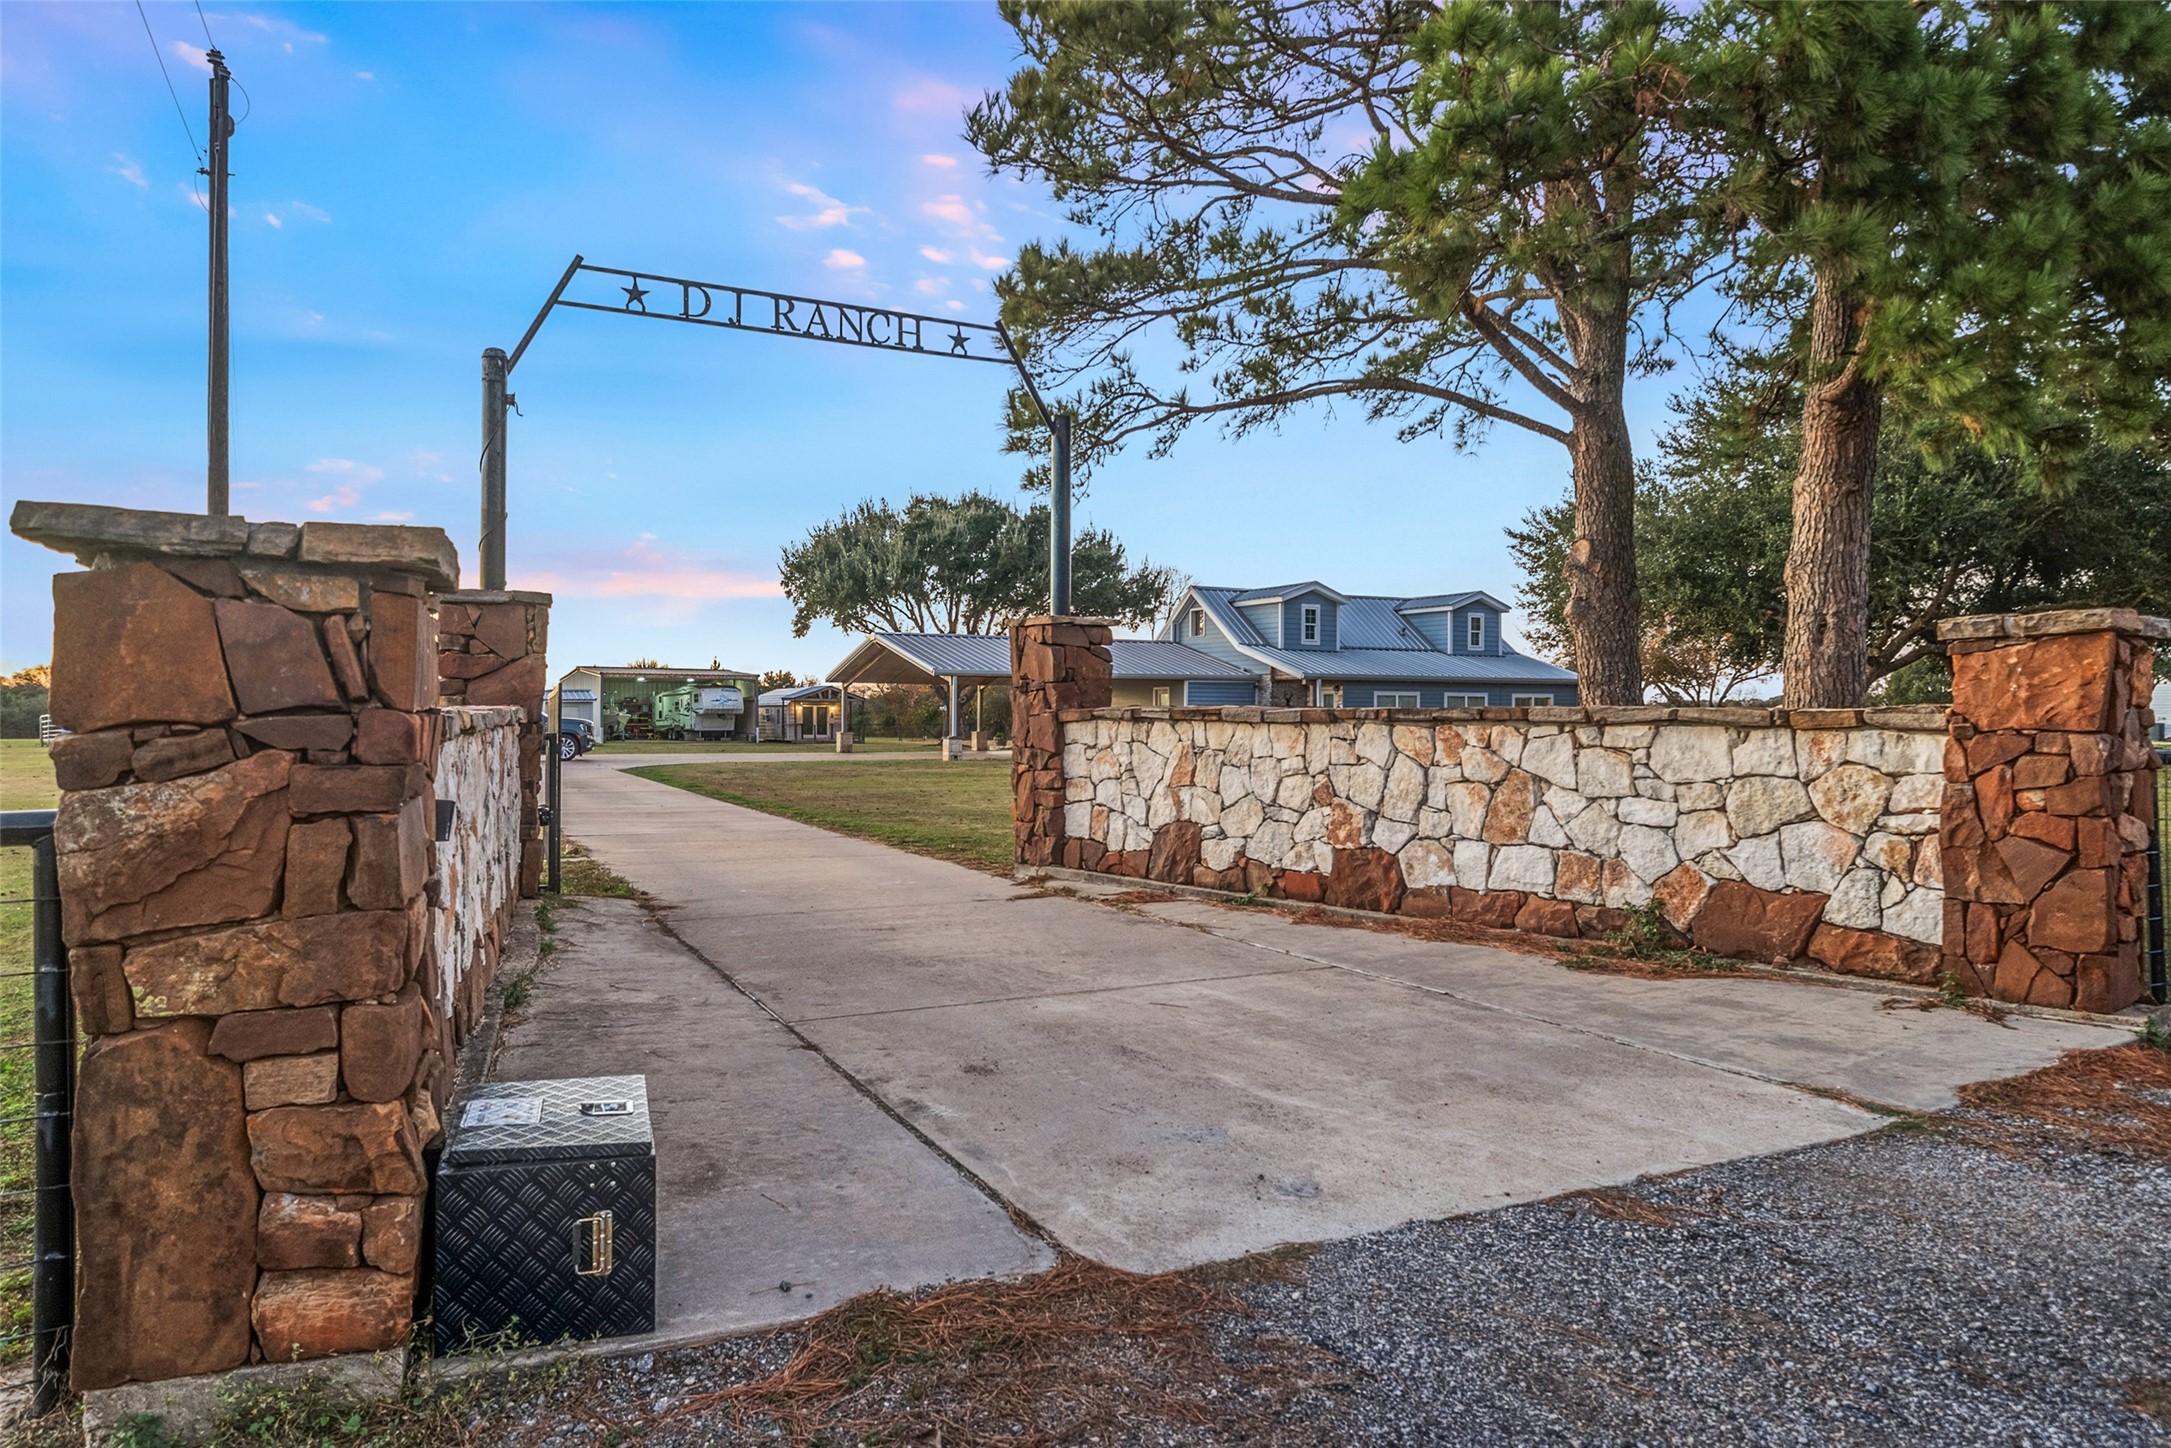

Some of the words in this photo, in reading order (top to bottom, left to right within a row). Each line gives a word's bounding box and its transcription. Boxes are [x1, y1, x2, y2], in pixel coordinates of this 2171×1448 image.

[679, 281, 711, 318] D
[728, 289, 749, 327] J
[770, 295, 924, 350] RANCH
